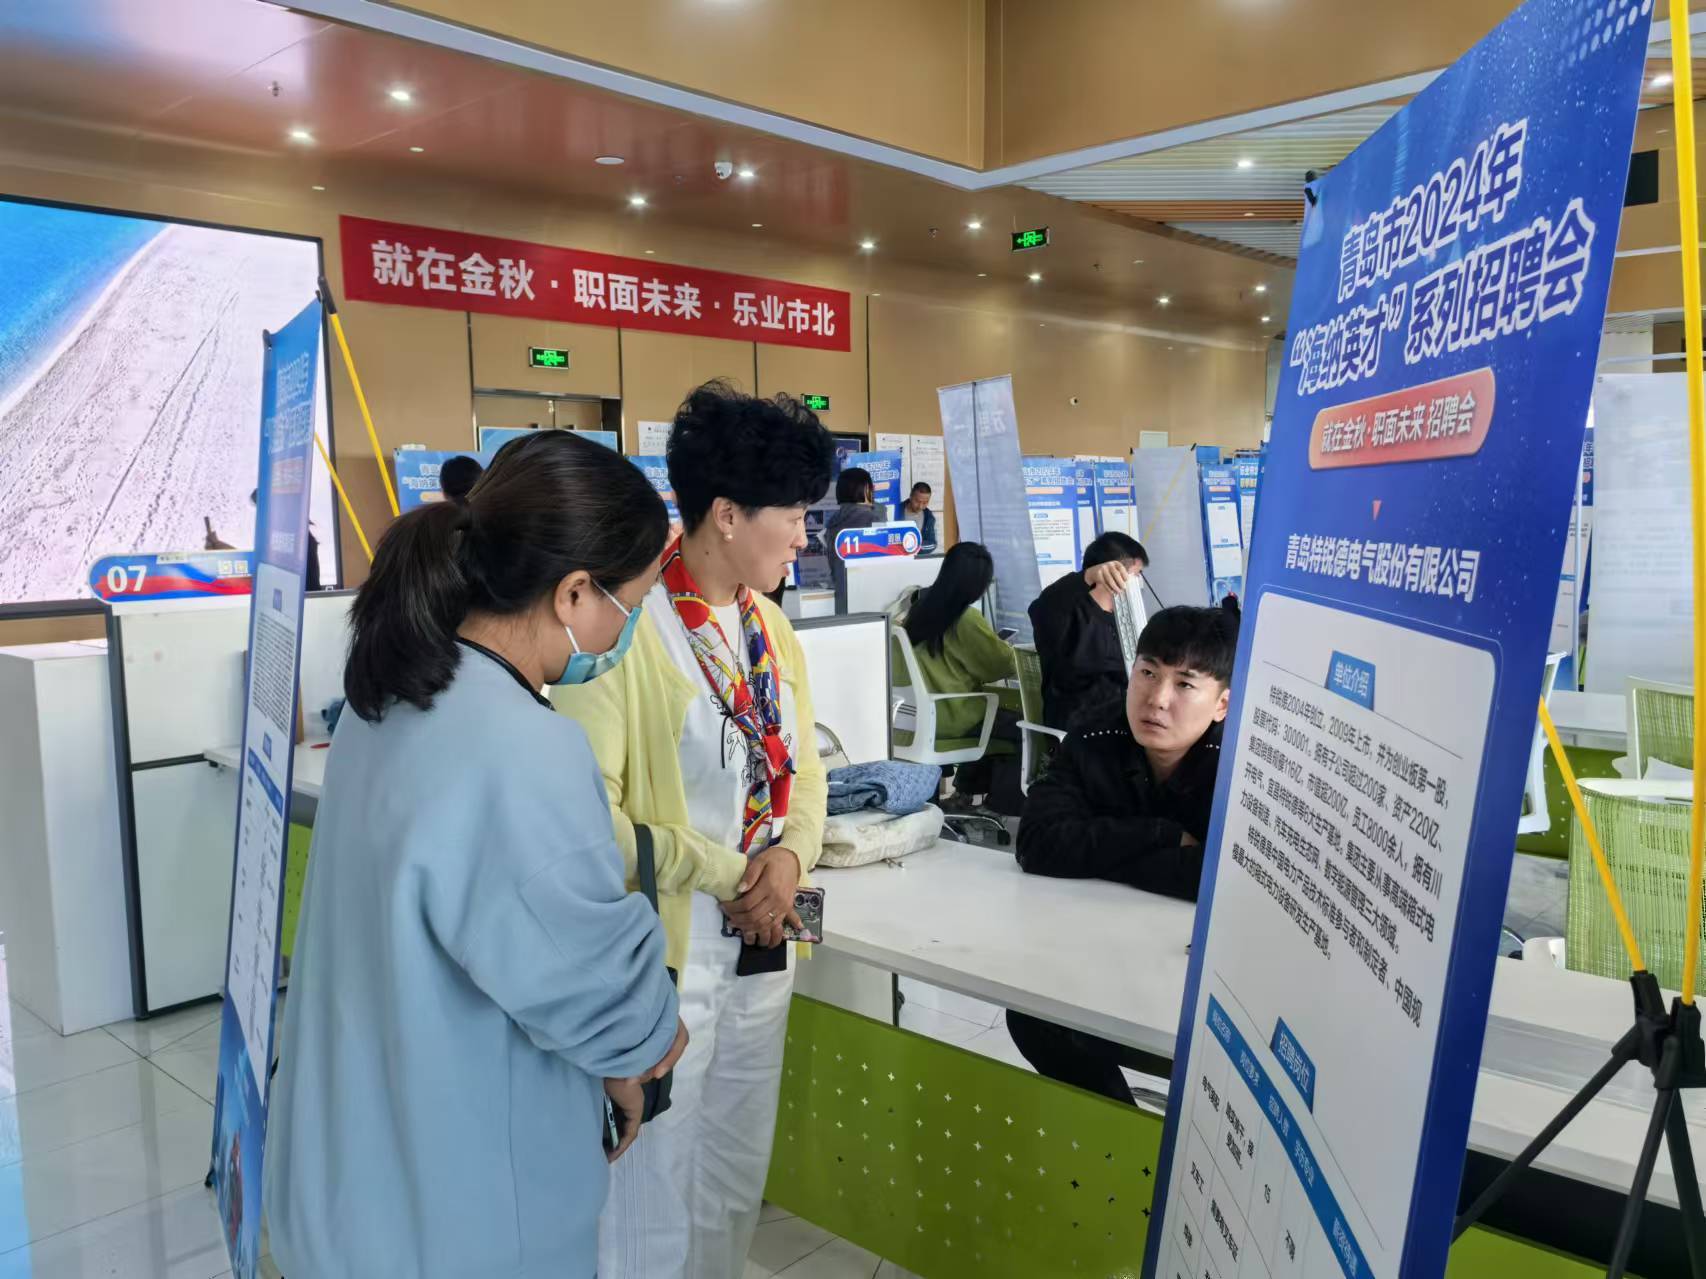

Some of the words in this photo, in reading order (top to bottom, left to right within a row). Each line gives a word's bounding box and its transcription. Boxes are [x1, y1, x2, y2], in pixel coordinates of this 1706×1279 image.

[1338, 118, 1528, 304] 青岛市2024年
[844, 536, 860, 554] 11
[1286, 533, 1480, 603] 青岛特锐德电气股份有限公司
[106, 565, 147, 593] 07
[1333, 661, 1370, 697] 单位介绍
[1278, 1031, 1312, 1094] 招聘岗位
